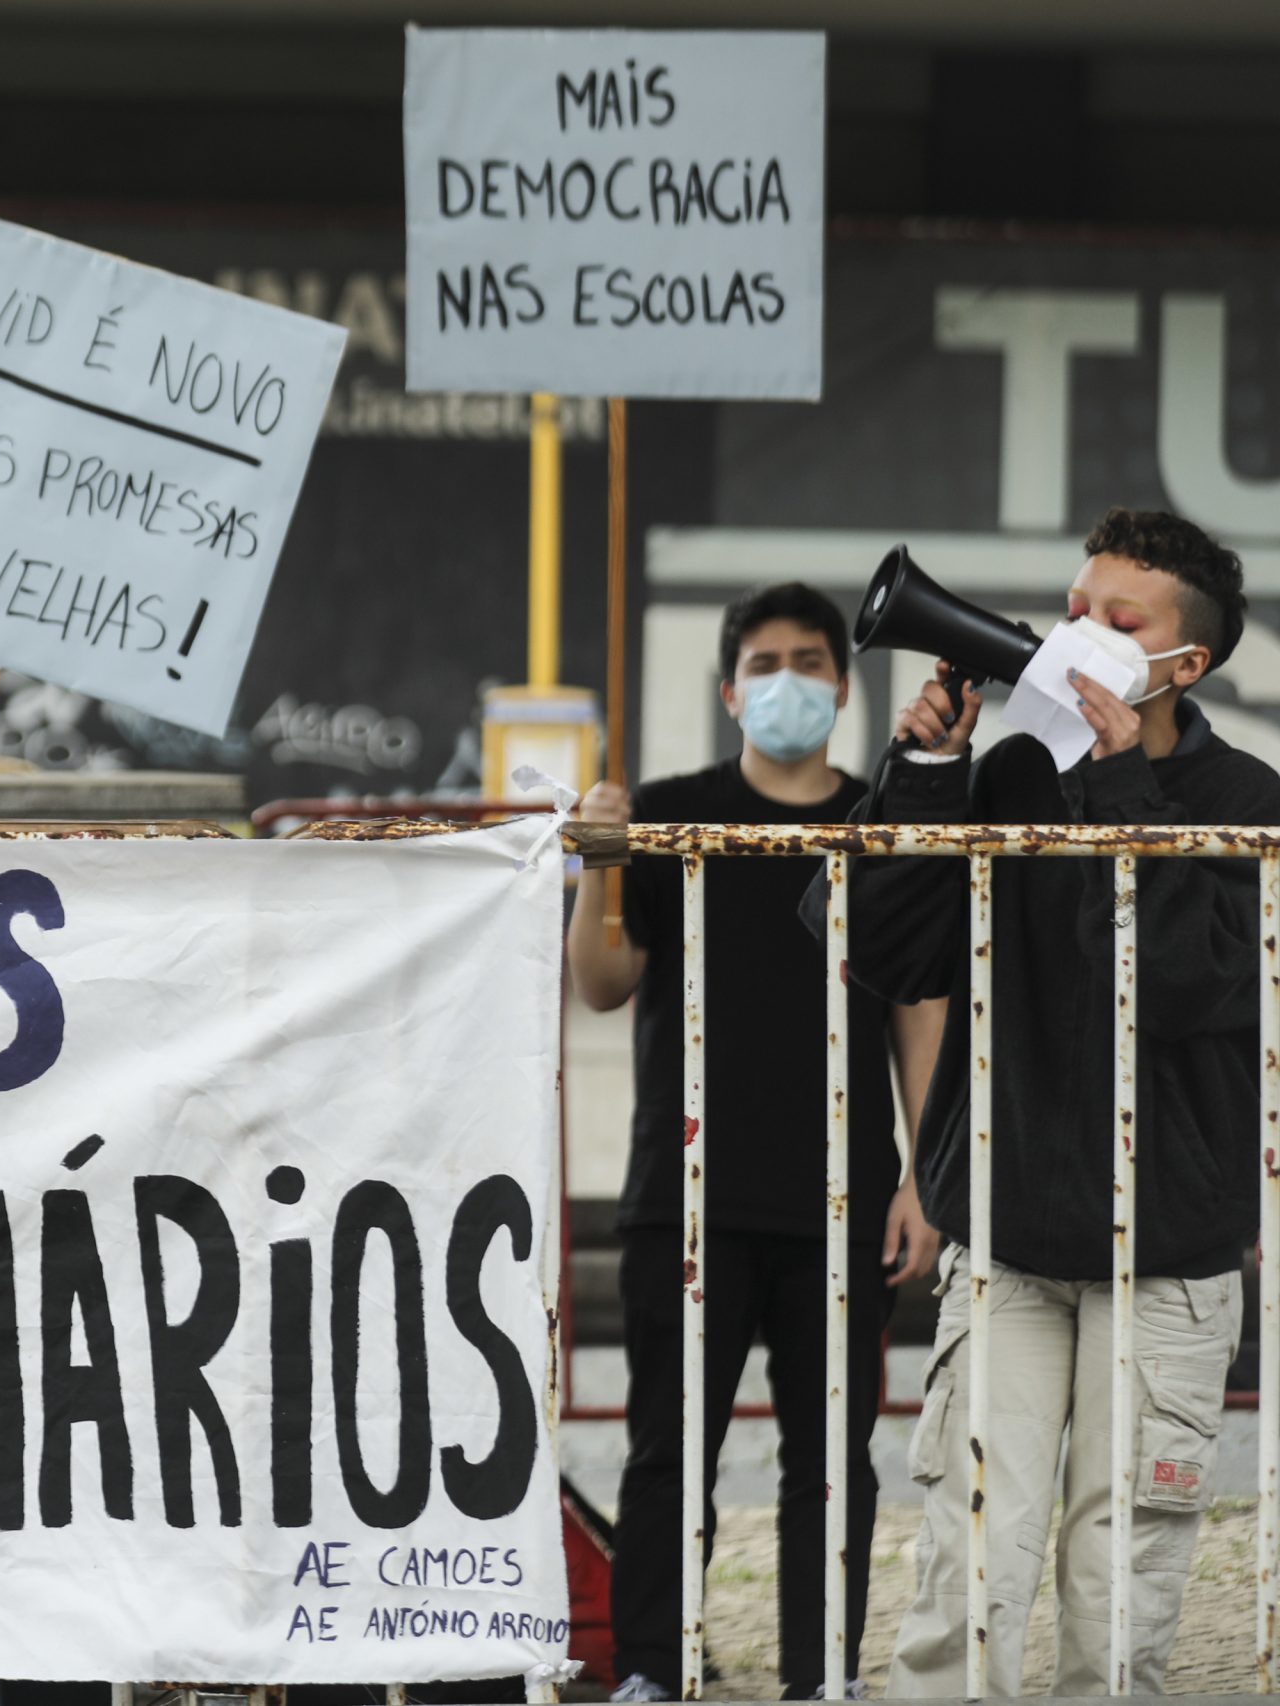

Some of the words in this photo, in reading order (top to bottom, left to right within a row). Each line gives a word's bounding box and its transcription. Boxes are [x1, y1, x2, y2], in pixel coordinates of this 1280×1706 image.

[437, 263, 545, 332] NAS
[573, 265, 785, 327] ESCOLAS
[84, 306, 123, 371] É
[150, 334, 286, 436] NOVO
[39, 449, 259, 559] PROMESSAS
[293, 1542, 351, 1589] AE
[378, 1546, 523, 1587] CAMOES
[286, 1604, 340, 1643] AE
[364, 1600, 479, 1641] ANTÓNIO
